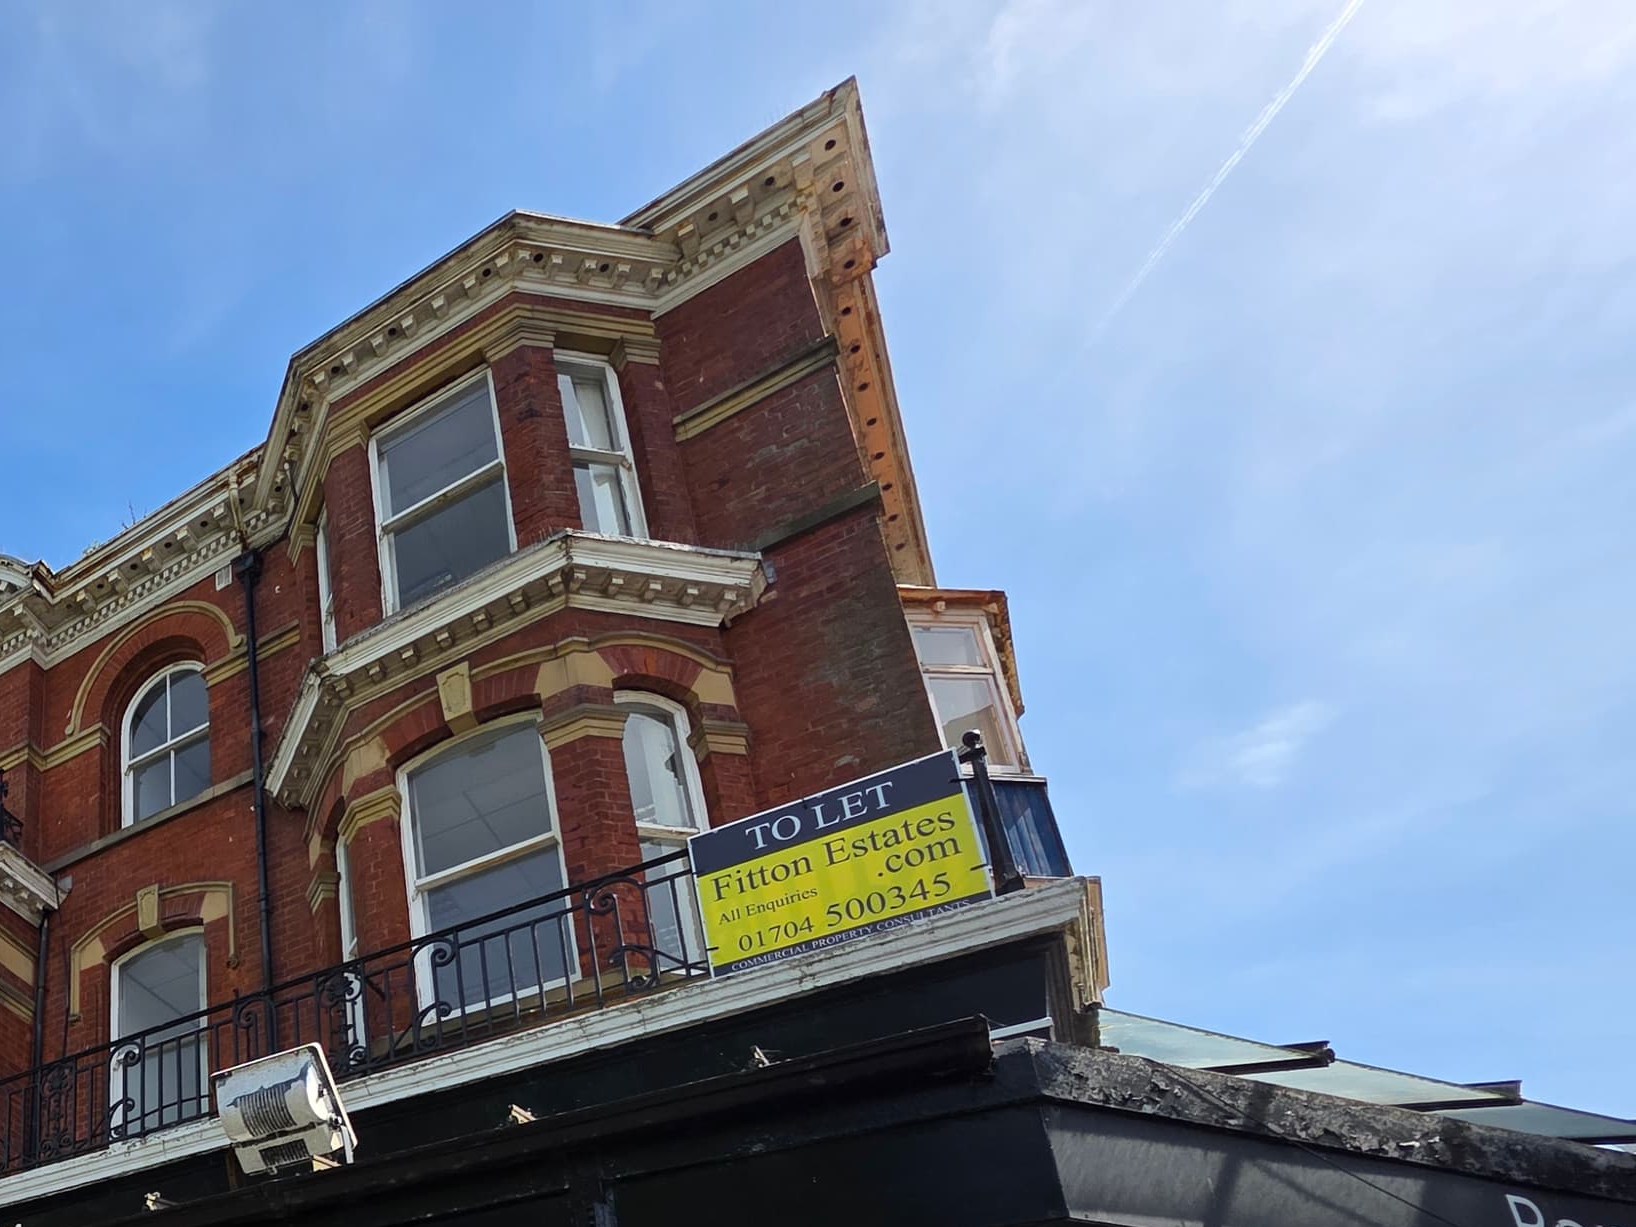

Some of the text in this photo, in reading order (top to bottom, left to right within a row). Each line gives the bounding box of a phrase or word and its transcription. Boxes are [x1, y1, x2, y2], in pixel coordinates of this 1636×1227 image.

[745, 781, 894, 850] TO LET
[710, 810, 956, 902] Fitton Estates
[877, 836, 962, 877] .com
[718, 886, 818, 925] All Enquiries
[738, 871, 952, 952] 01704 500345
[731, 942, 809, 972] COMMERCIAL
[812, 924, 873, 948] PROPERTY
